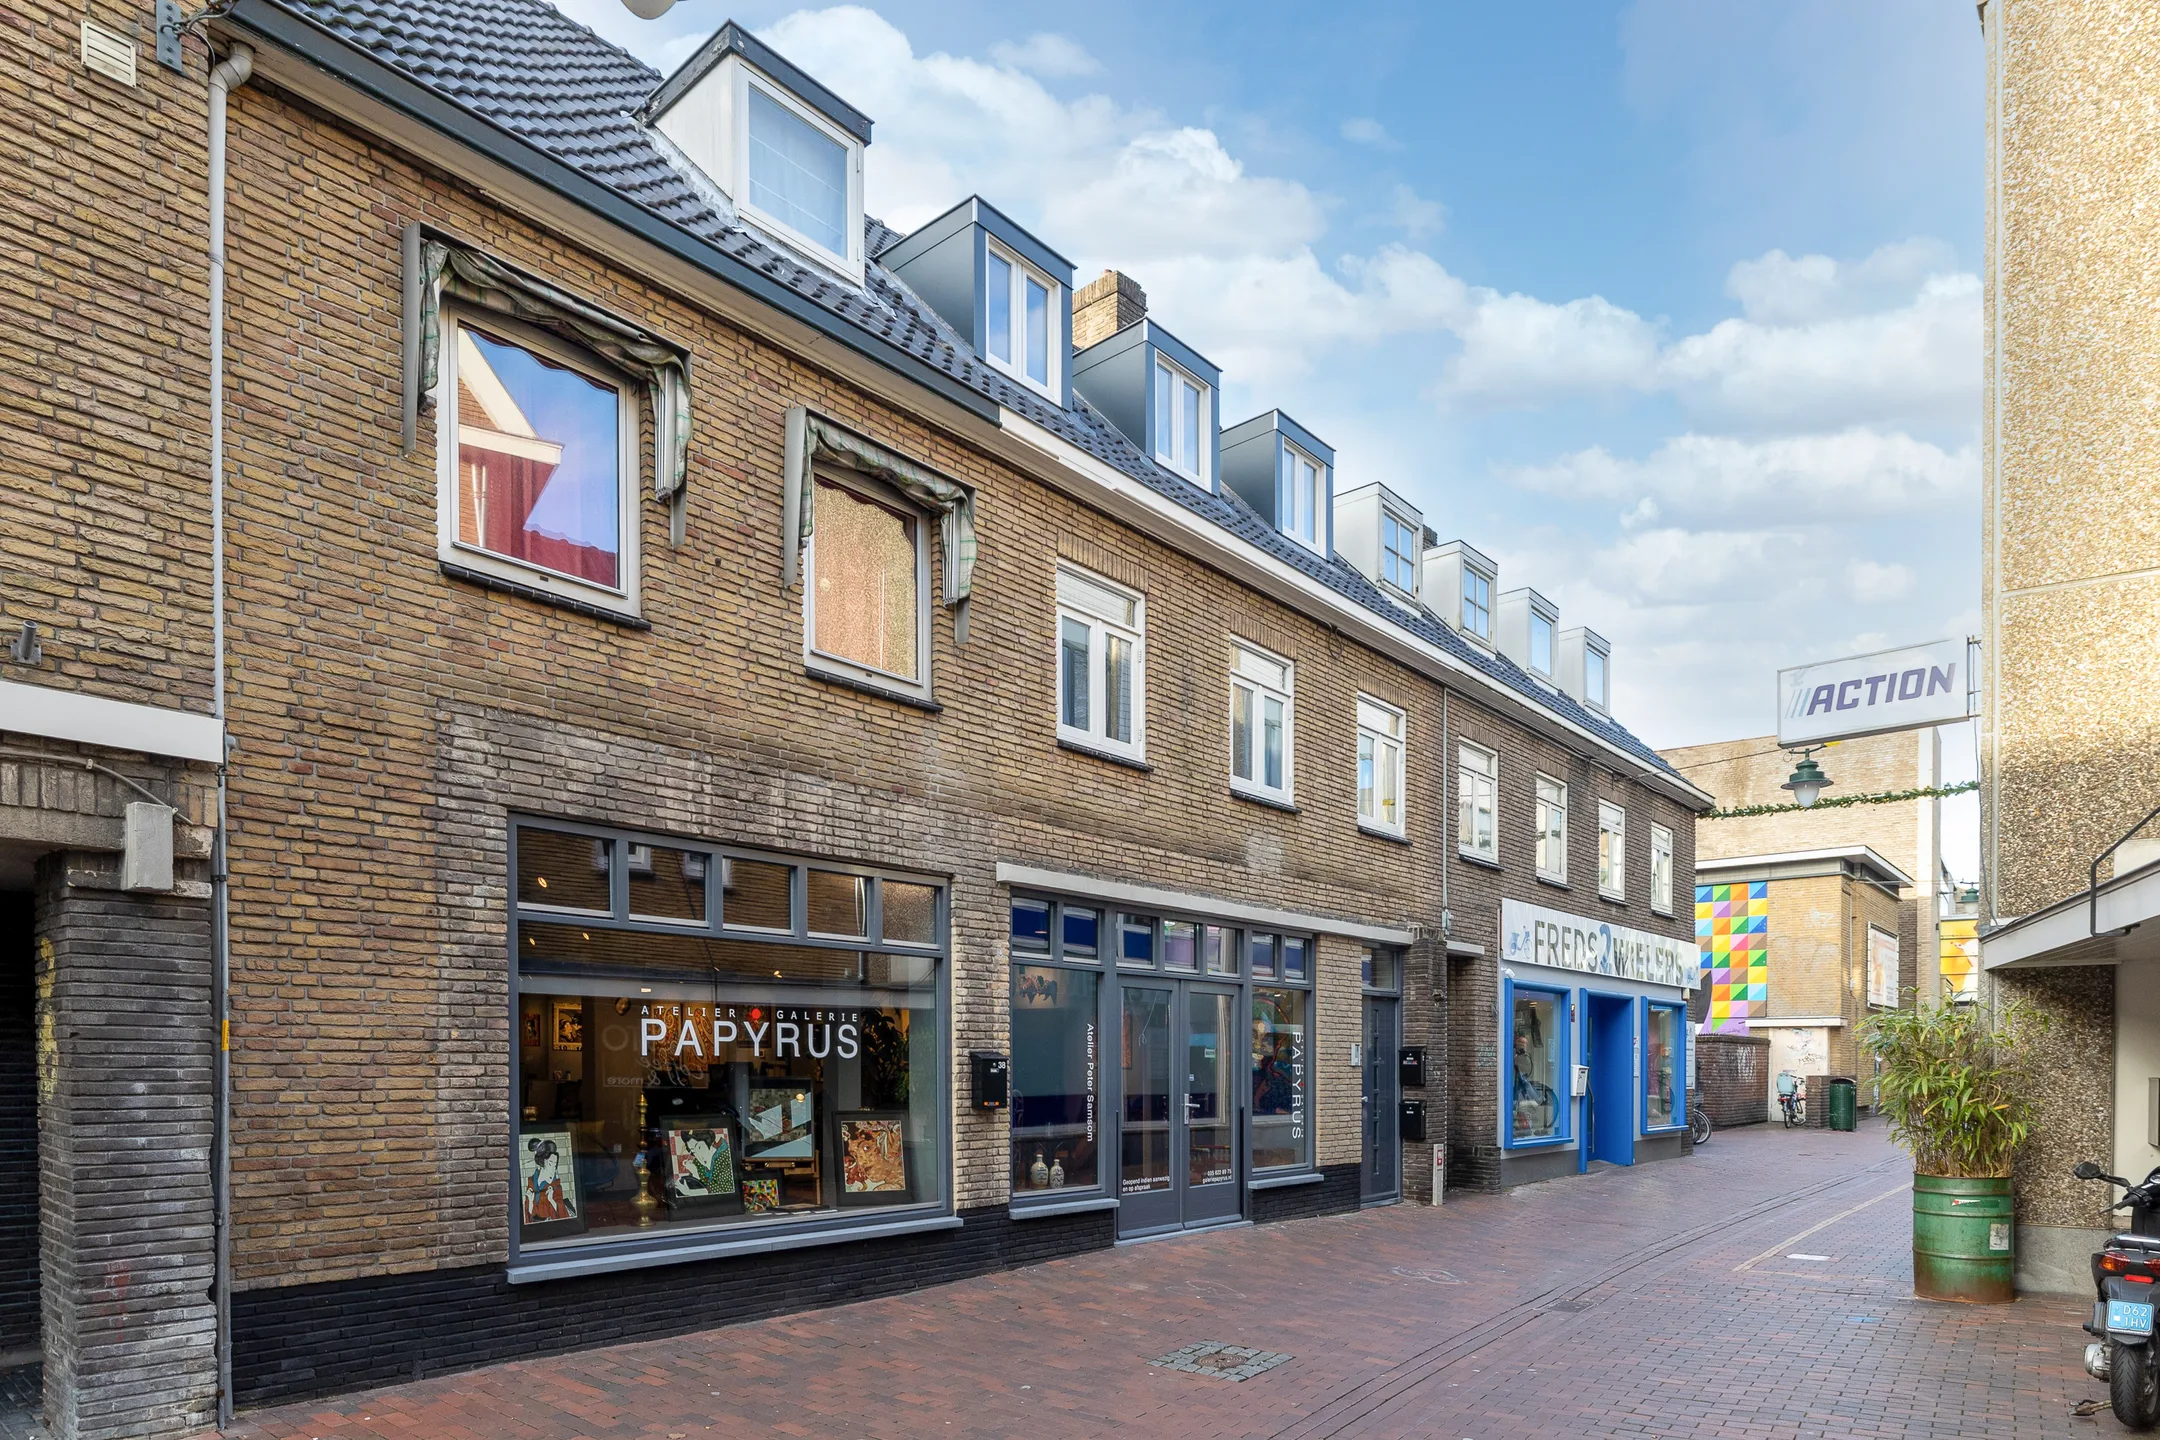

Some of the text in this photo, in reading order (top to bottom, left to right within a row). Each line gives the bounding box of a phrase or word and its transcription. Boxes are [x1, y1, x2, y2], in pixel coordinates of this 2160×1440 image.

[1806, 662, 1957, 716] ACTION
[641, 1005, 858, 1022] ATELIER GALERIE
[641, 1018, 859, 1059] PAPYRUS
[998, 1061, 1006, 1069] 38
[1086, 1023, 1095, 1142] Atelier Peter Samsom
[1291, 1031, 1301, 1139] PAPYRUS
[2123, 1305, 2148, 1317] D62
[2124, 1317, 2147, 1328] 1HV
